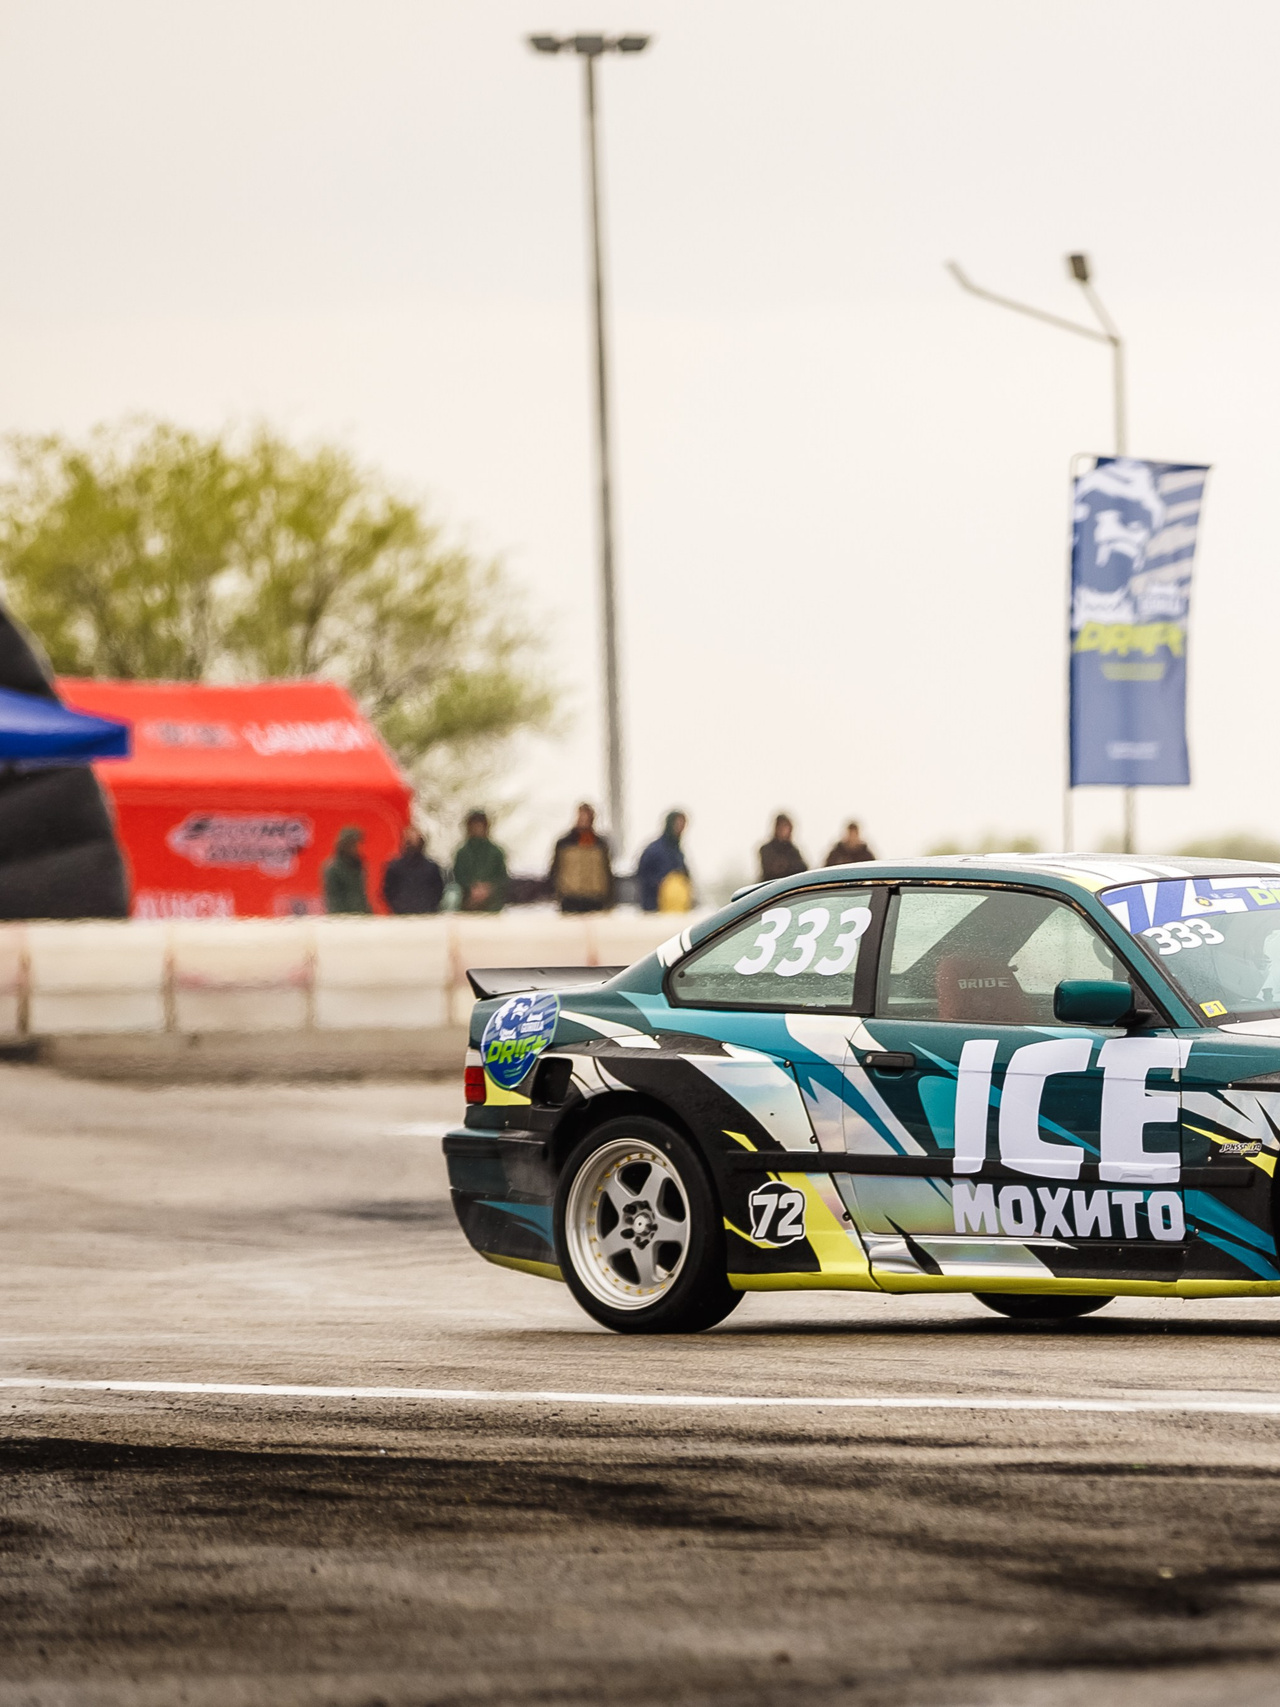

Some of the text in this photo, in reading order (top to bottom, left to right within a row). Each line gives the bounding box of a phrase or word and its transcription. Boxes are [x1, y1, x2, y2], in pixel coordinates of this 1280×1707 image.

[734, 907, 873, 976] 333
[1142, 918, 1225, 956] 333
[958, 977, 1011, 989] BRIDE
[952, 1037, 1193, 1183] ICE
[753, 1192, 804, 1238] 72
[952, 1183, 1186, 1241] МОХИТО
